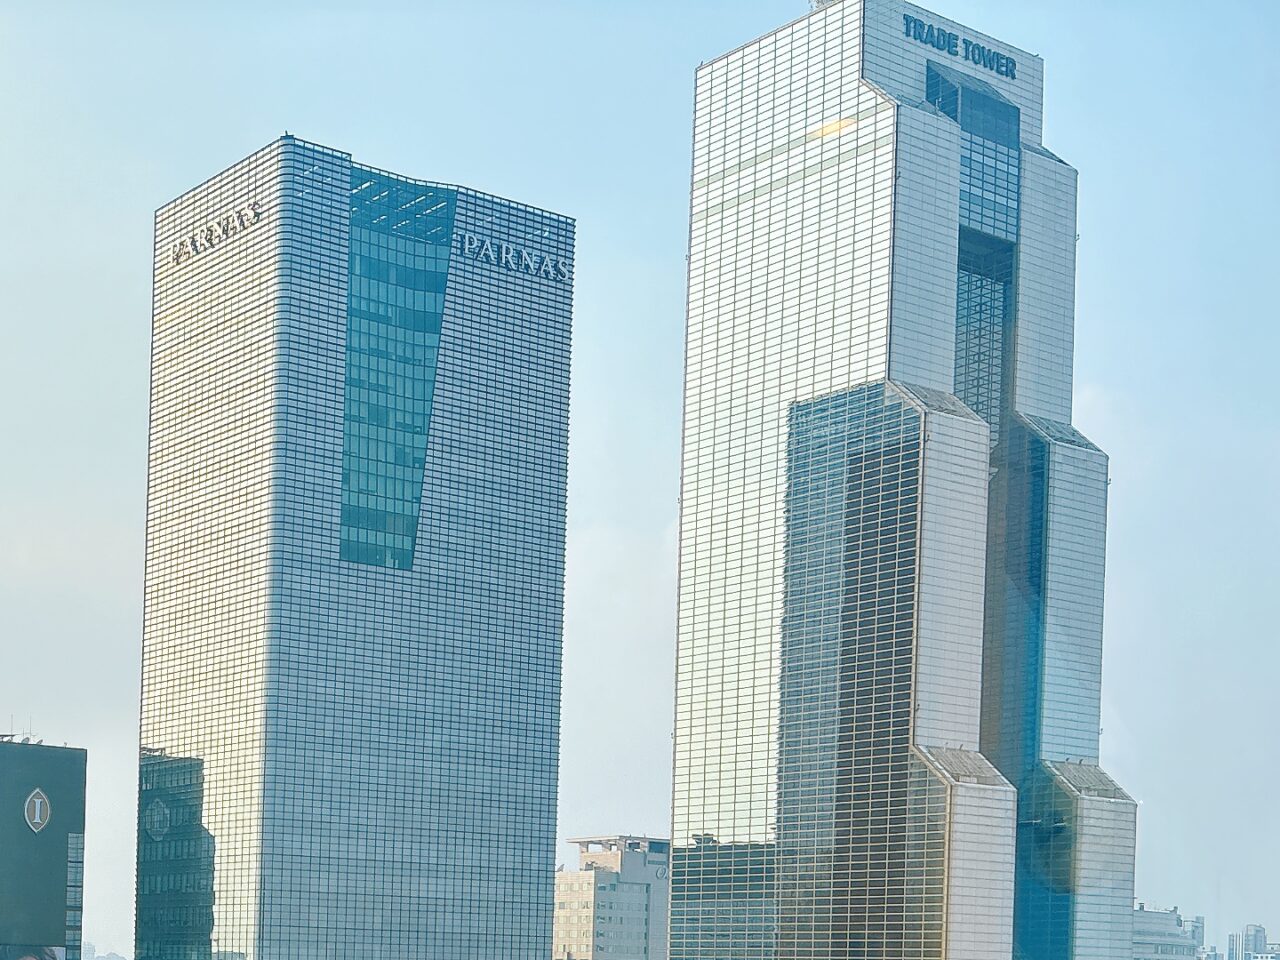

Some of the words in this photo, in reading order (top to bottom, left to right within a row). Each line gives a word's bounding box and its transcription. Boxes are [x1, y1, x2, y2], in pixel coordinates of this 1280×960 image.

[903, 13, 959, 56] TRADE
[962, 38, 1017, 80] TOWER
[169, 201, 262, 265] PARNAS
[463, 233, 570, 281] PARNAS
